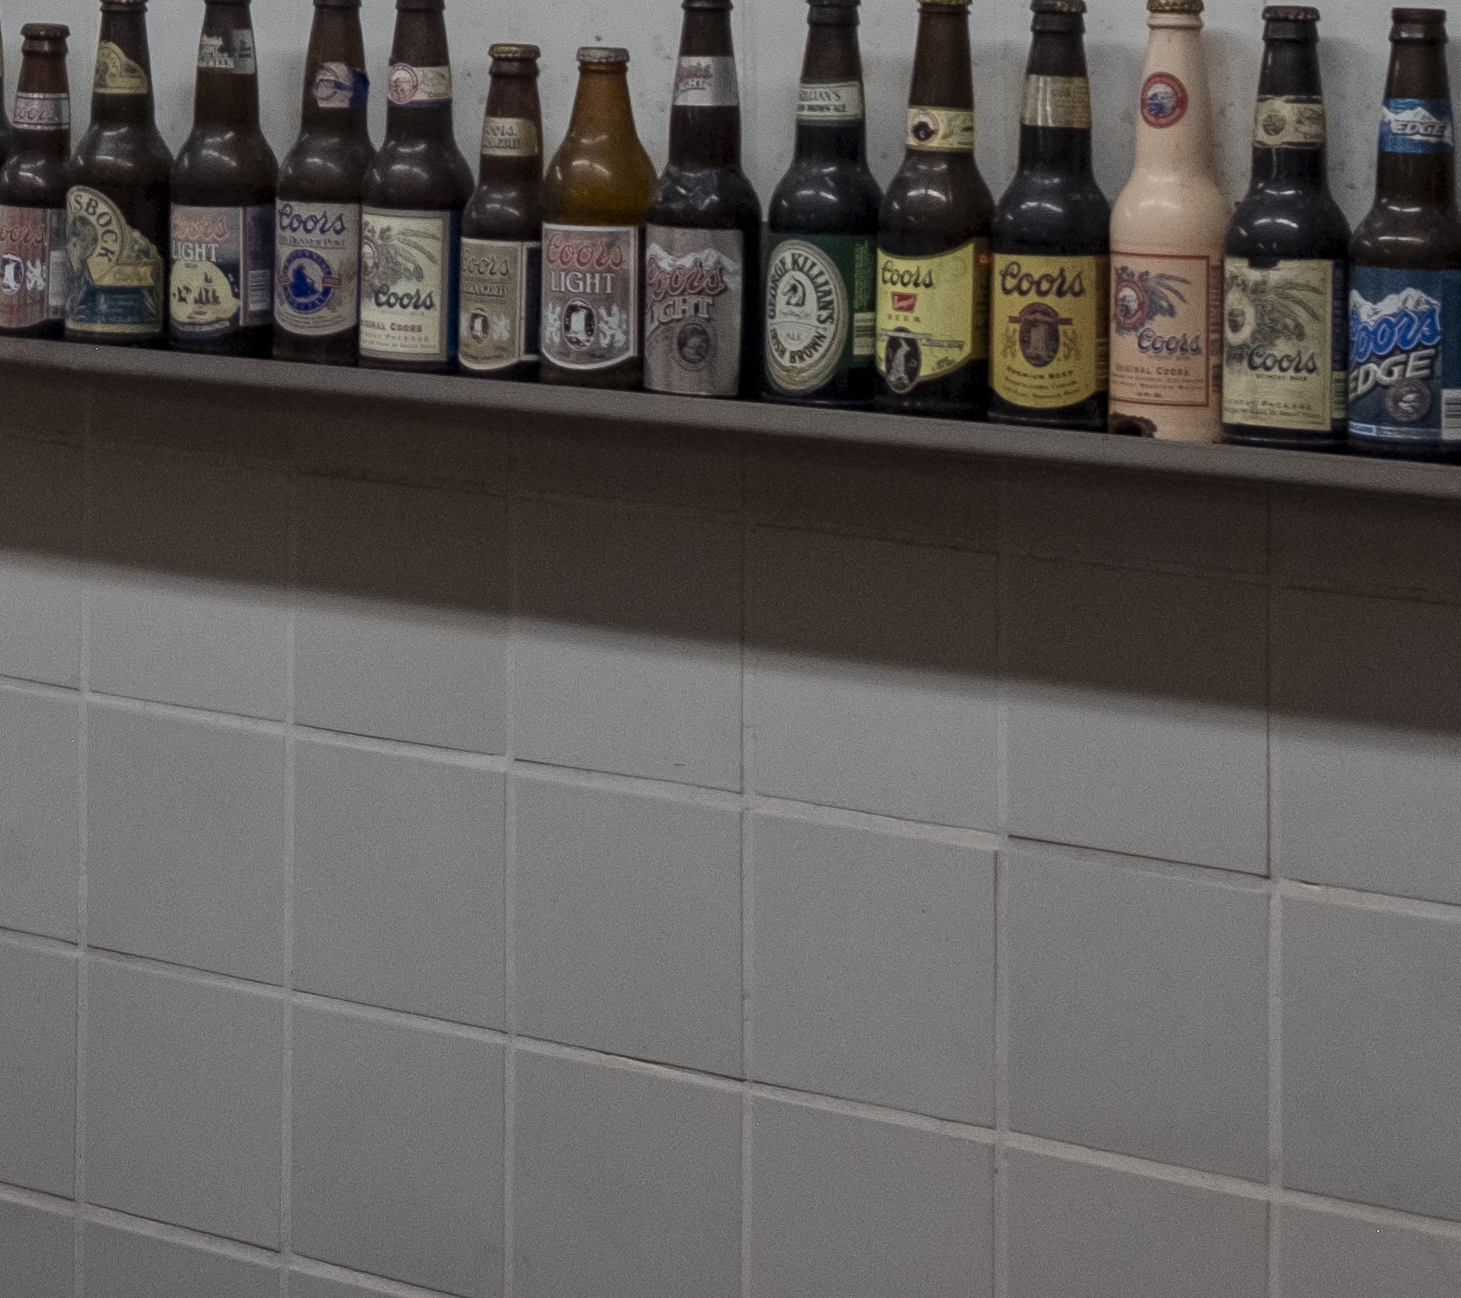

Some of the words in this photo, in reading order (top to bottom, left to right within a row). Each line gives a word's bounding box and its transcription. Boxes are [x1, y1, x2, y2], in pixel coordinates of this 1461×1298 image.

[1393, 118, 1450, 139] EDGE
[73, 193, 120, 264] SBOCK
[277, 202, 346, 234] Coors
[544, 232, 626, 269] Coors
[549, 270, 616, 294] LIGHT
[647, 258, 730, 301] Coors
[789, 252, 836, 326] KILLIAN'S
[880, 260, 935, 289] Coors
[999, 260, 1087, 299] Coors
[373, 284, 435, 311] Coors
[789, 327, 828, 365] BROWN
[1136, 327, 1203, 355] Coors
[1246, 344, 1321, 375] Coors
